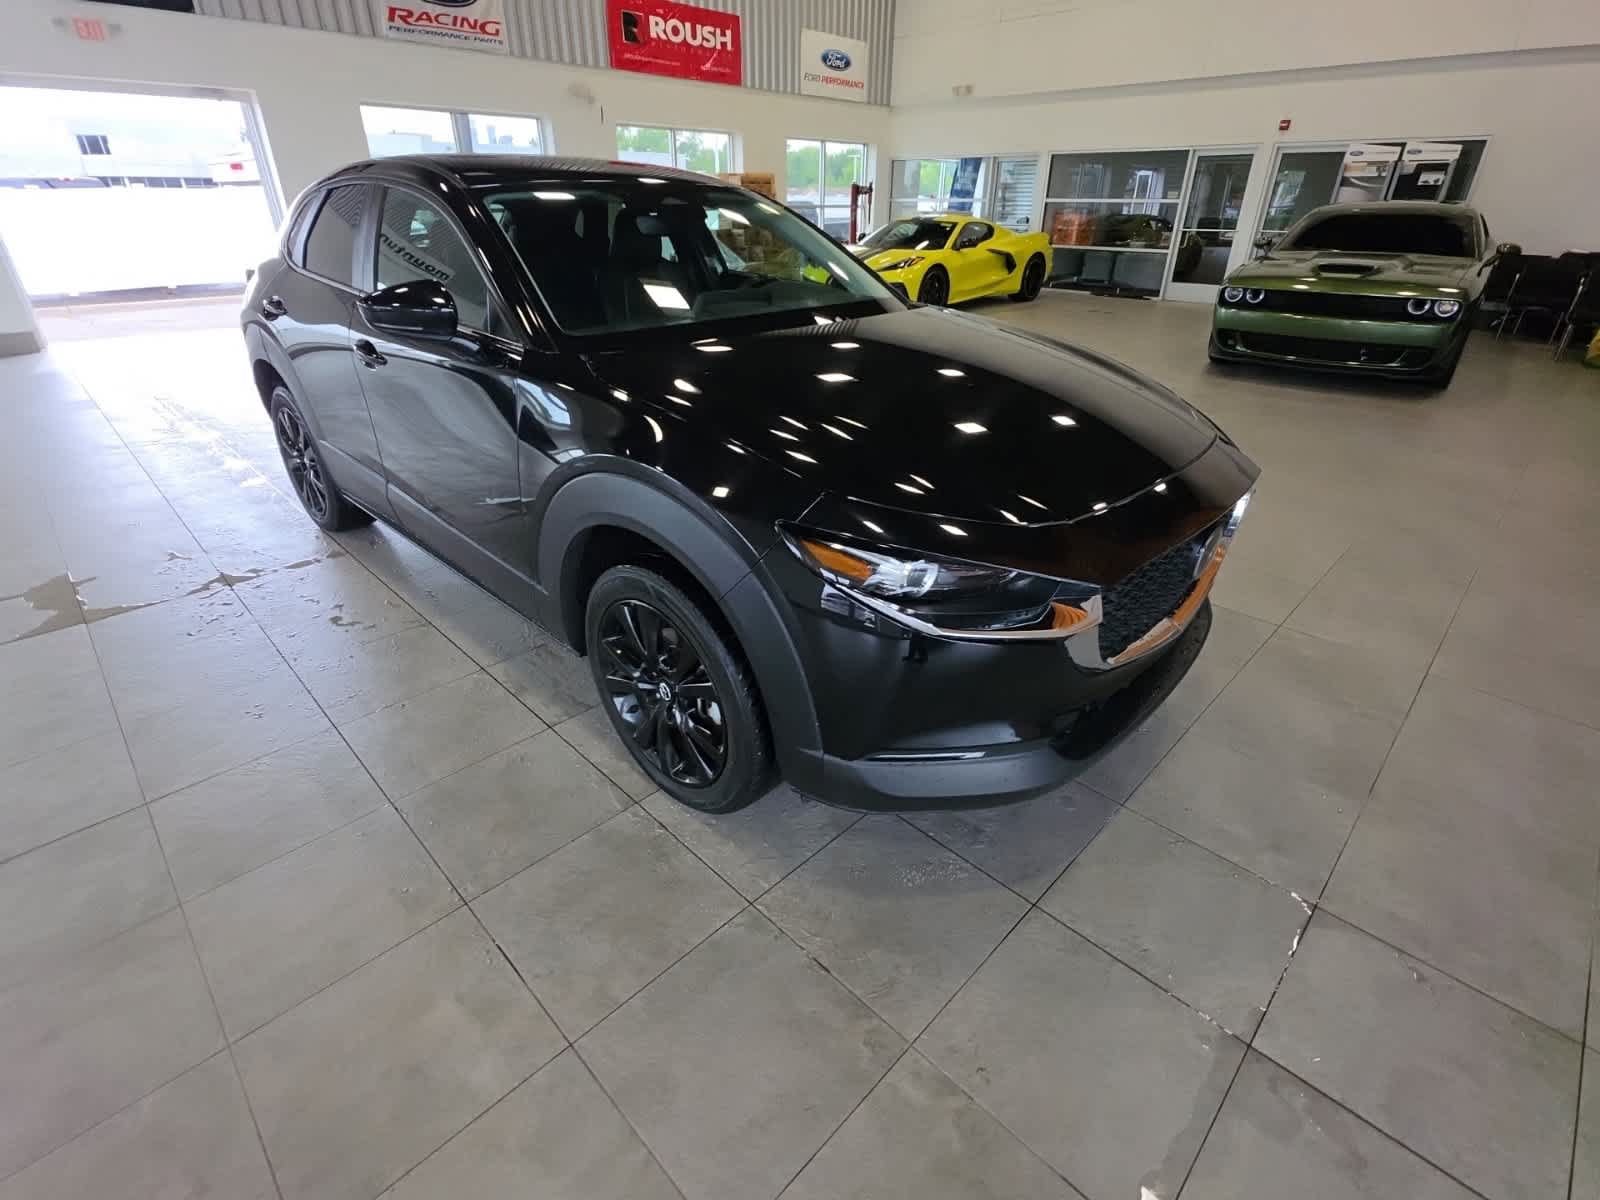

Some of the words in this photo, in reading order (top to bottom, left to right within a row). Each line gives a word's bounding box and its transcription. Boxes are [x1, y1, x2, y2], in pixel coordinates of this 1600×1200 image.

[387, 6, 501, 36] RACING
[388, 25, 472, 41] PERFORMANCE
[649, 15, 732, 51] ROUSH
[826, 51, 846, 68] Ford
